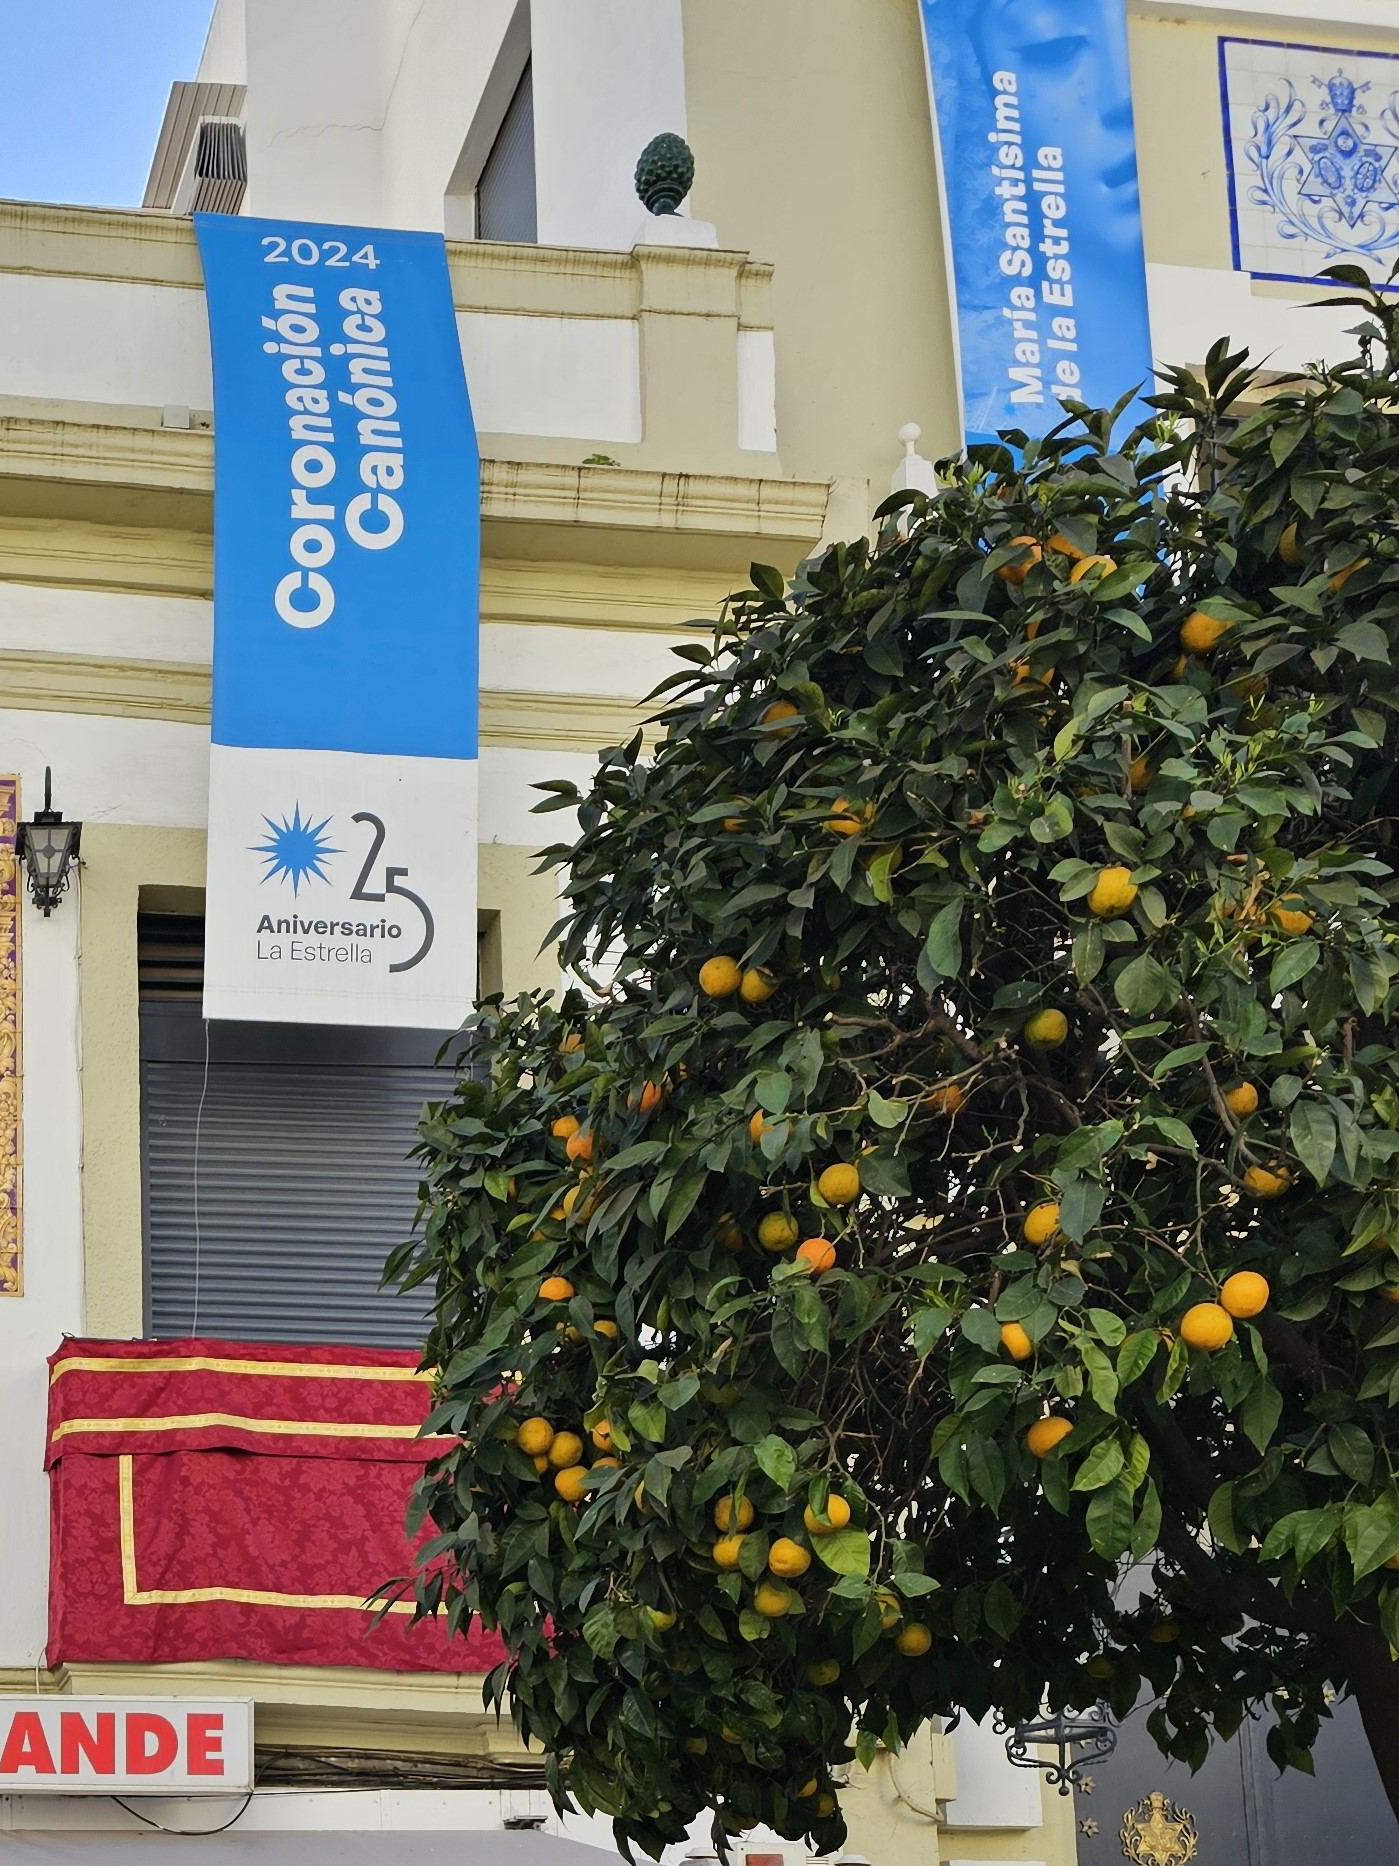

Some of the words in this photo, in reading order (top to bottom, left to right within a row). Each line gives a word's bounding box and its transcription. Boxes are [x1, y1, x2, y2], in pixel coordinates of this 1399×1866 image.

[988, 70, 1034, 278] Santísima
[1032, 146, 1075, 308] Estrella
[261, 236, 381, 271] 2024
[1002, 287, 1044, 404] María
[1047, 317, 1078, 352] la
[1049, 358, 1081, 401] de
[264, 283, 337, 630] Coronación
[329, 287, 405, 551] Canónica
[256, 914, 402, 941] Aniversario
[349, 812, 435, 974] 25
[256, 940, 285, 962] La
[290, 942, 373, 965] Estrella
